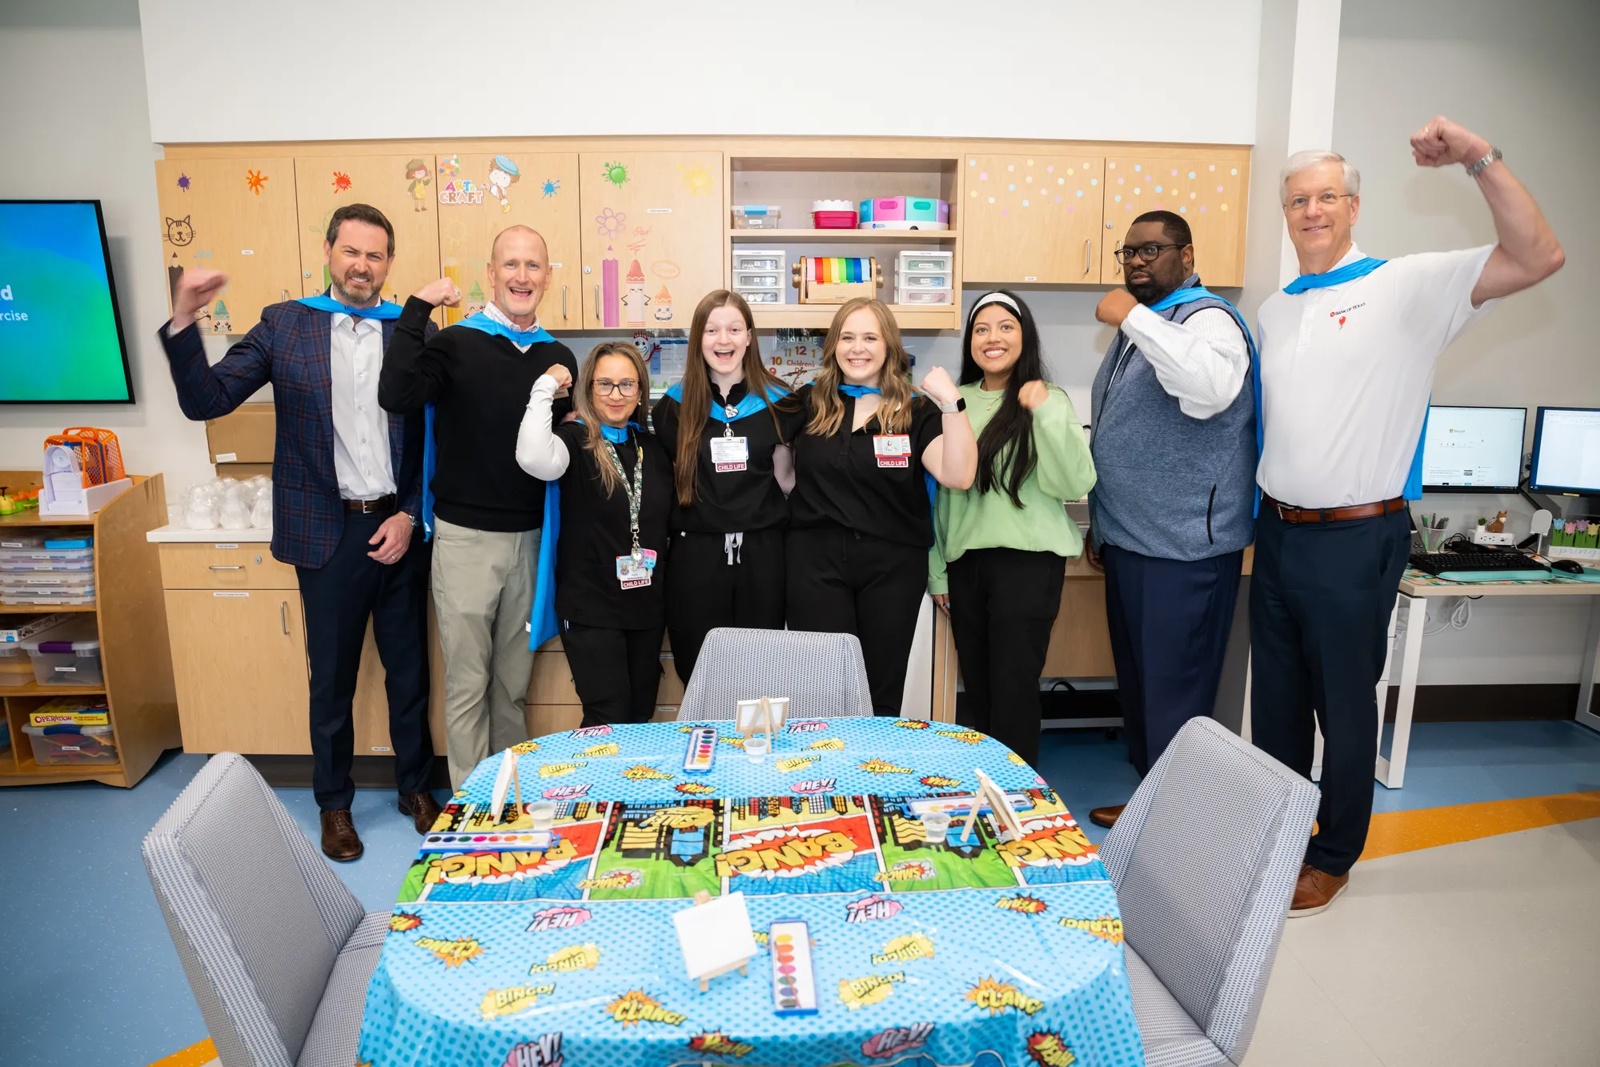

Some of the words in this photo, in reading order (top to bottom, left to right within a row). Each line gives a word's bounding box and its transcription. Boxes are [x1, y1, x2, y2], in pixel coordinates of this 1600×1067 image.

[444, 180, 472, 192] ART
[439, 190, 483, 204] CRAFT
[771, 356, 782, 366] 10
[795, 346, 806, 356] 12
[787, 722, 820, 734] HEY!
[866, 764, 914, 774] CLANG!
[552, 784, 594, 796] HEY!
[800, 778, 837, 791] HEY!
[714, 832, 858, 876] BANG!
[525, 912, 579, 932] HEY!
[846, 902, 891, 923] HEY!
[1058, 917, 1124, 936] CLANG!
[528, 952, 588, 976] BINGO!
[850, 971, 905, 998] BINGO!
[496, 982, 556, 1009] BINGO!
[976, 990, 1044, 1016] CLANG!
[614, 1000, 687, 1026] CLANG!
[876, 1022, 936, 1052] HEY!
[516, 1032, 562, 1067] HEY!
